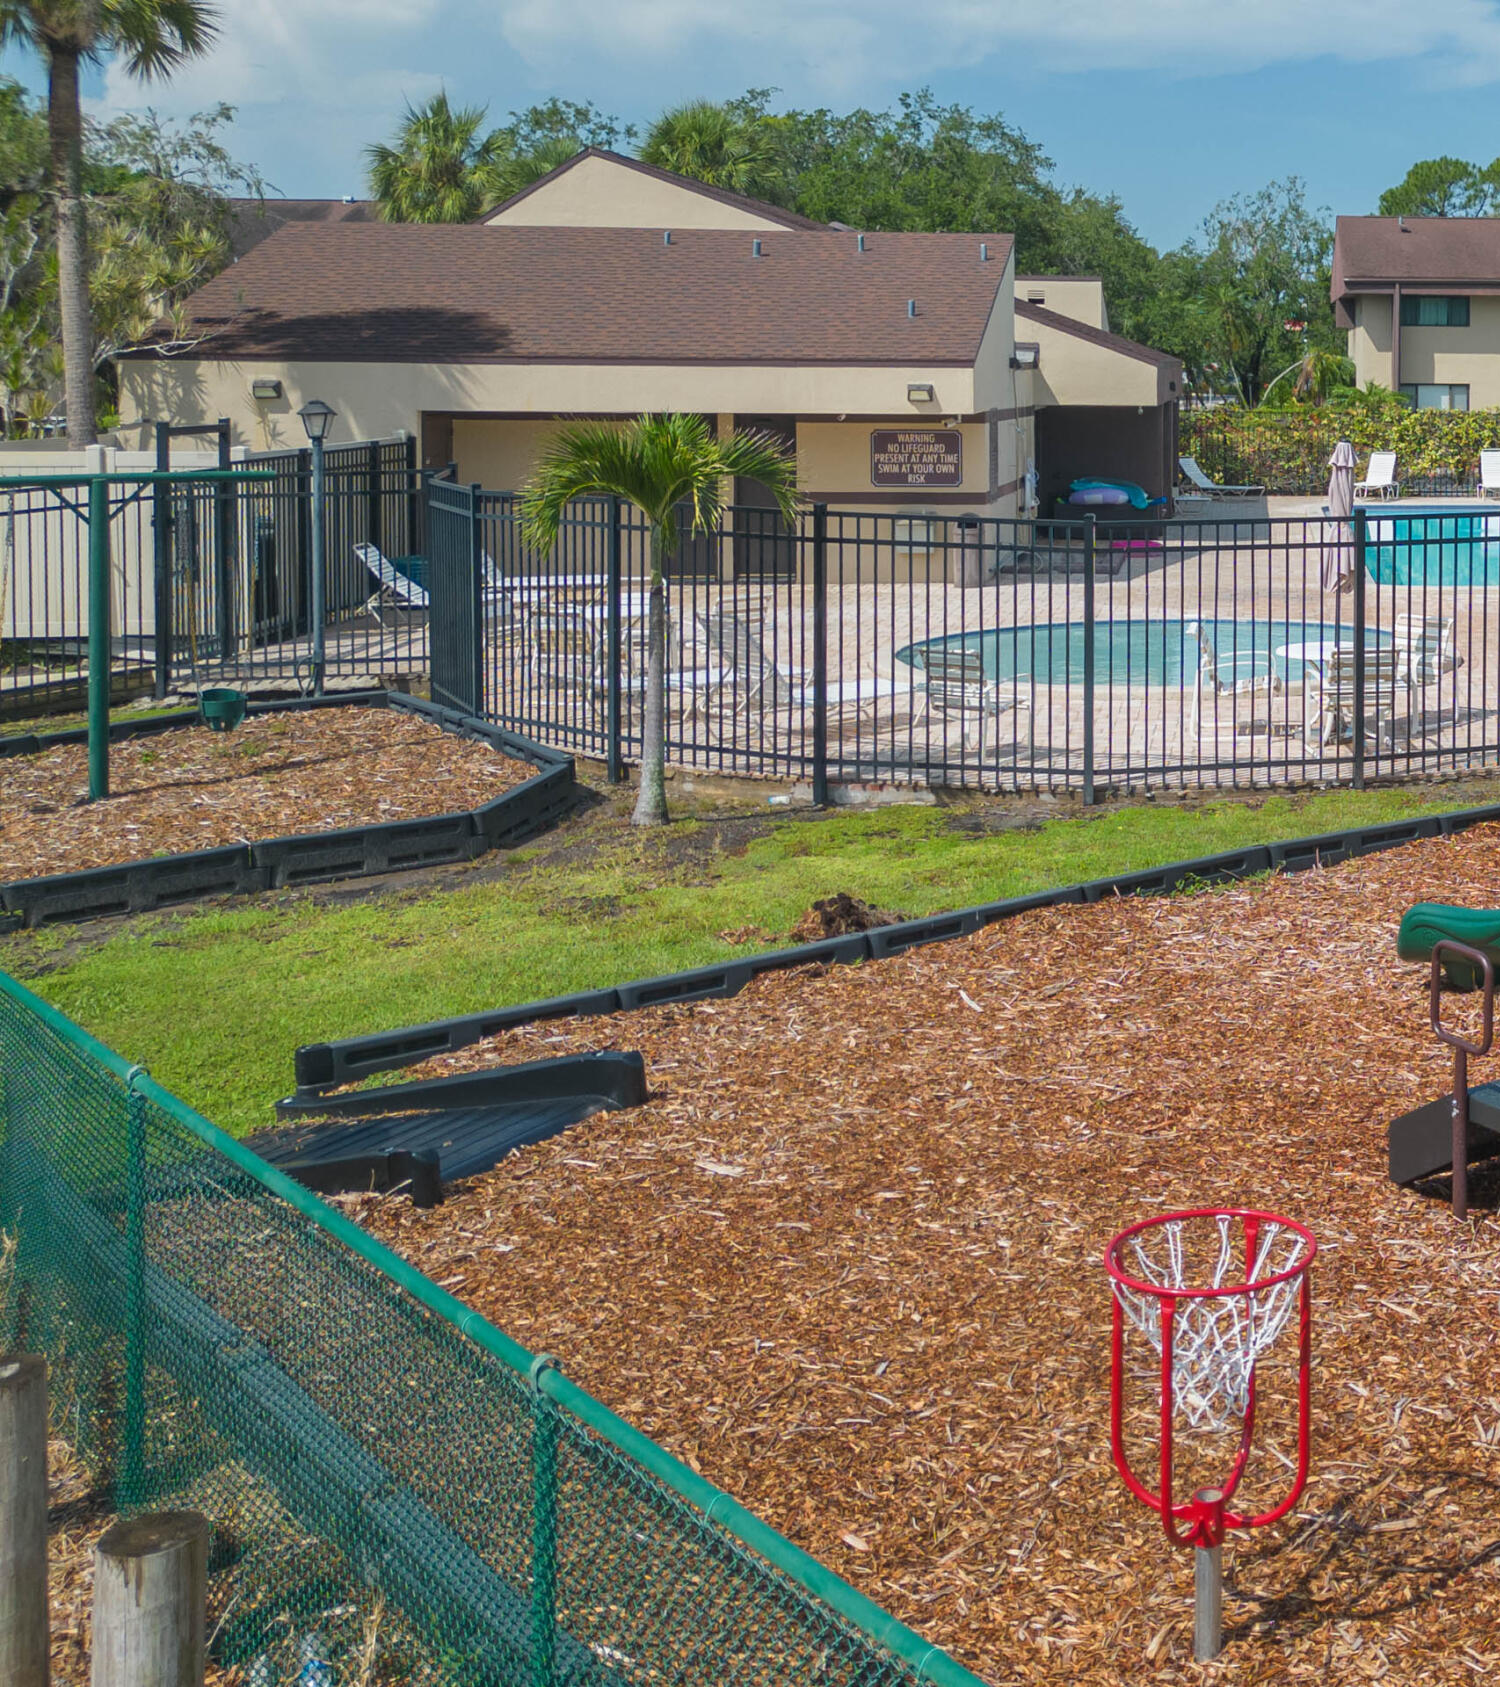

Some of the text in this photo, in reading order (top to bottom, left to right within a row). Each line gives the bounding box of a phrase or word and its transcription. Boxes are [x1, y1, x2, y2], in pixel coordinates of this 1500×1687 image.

[898, 434, 935, 443] WARNING
[888, 443, 945, 453] NO LIFEGUARD
[875, 454, 958, 463] PRESENT AT ANY TIME
[878, 464, 954, 473] SWIM AT YOUR OWN
[908, 474, 925, 483] RISK
